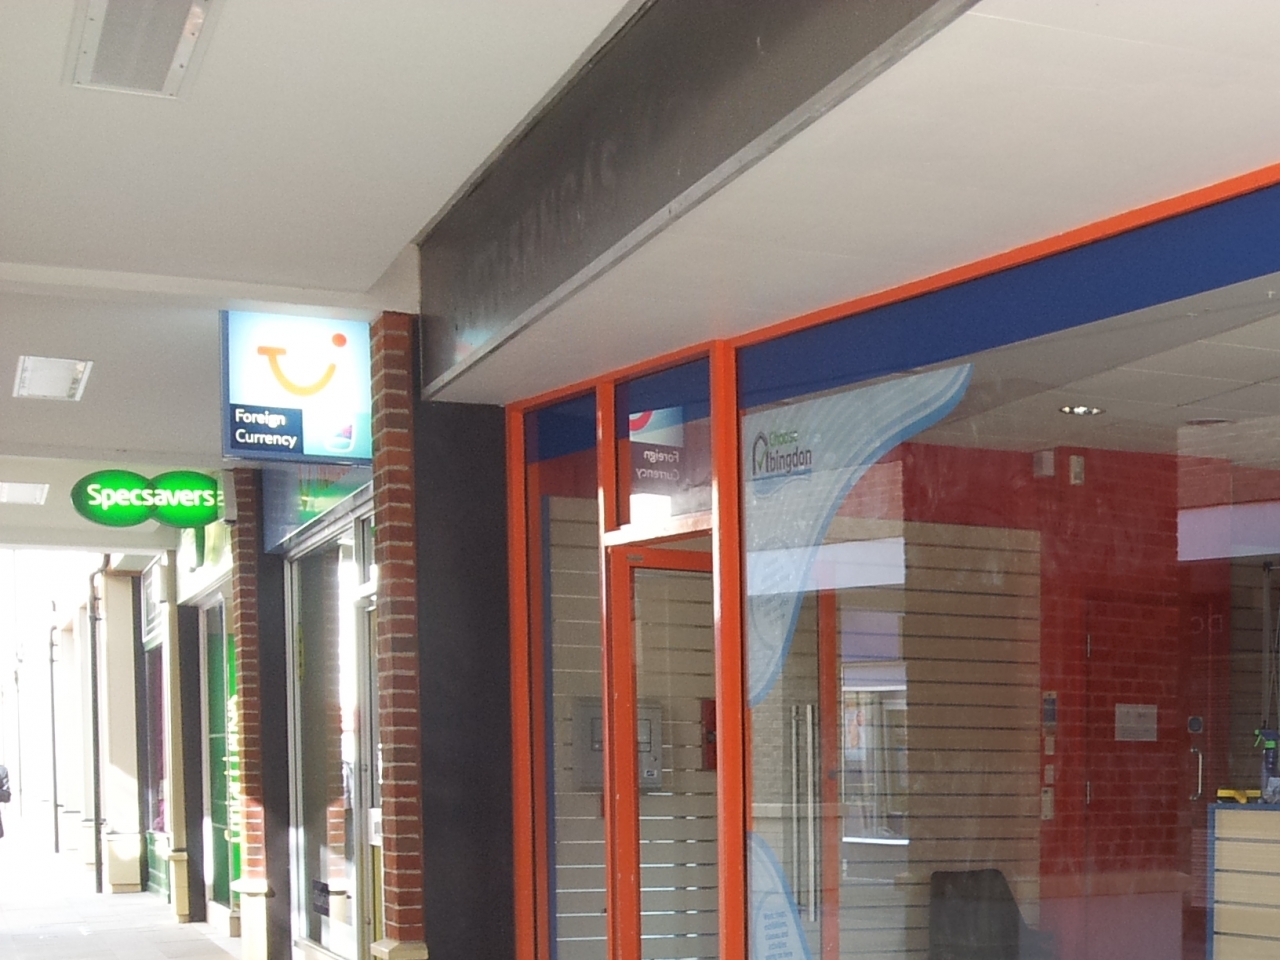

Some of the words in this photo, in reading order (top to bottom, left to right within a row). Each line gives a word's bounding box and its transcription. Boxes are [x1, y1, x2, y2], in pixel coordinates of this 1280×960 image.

[234, 408, 287, 429] Foreign
[235, 429, 297, 449] Currency
[86, 484, 215, 511] Specsavers
